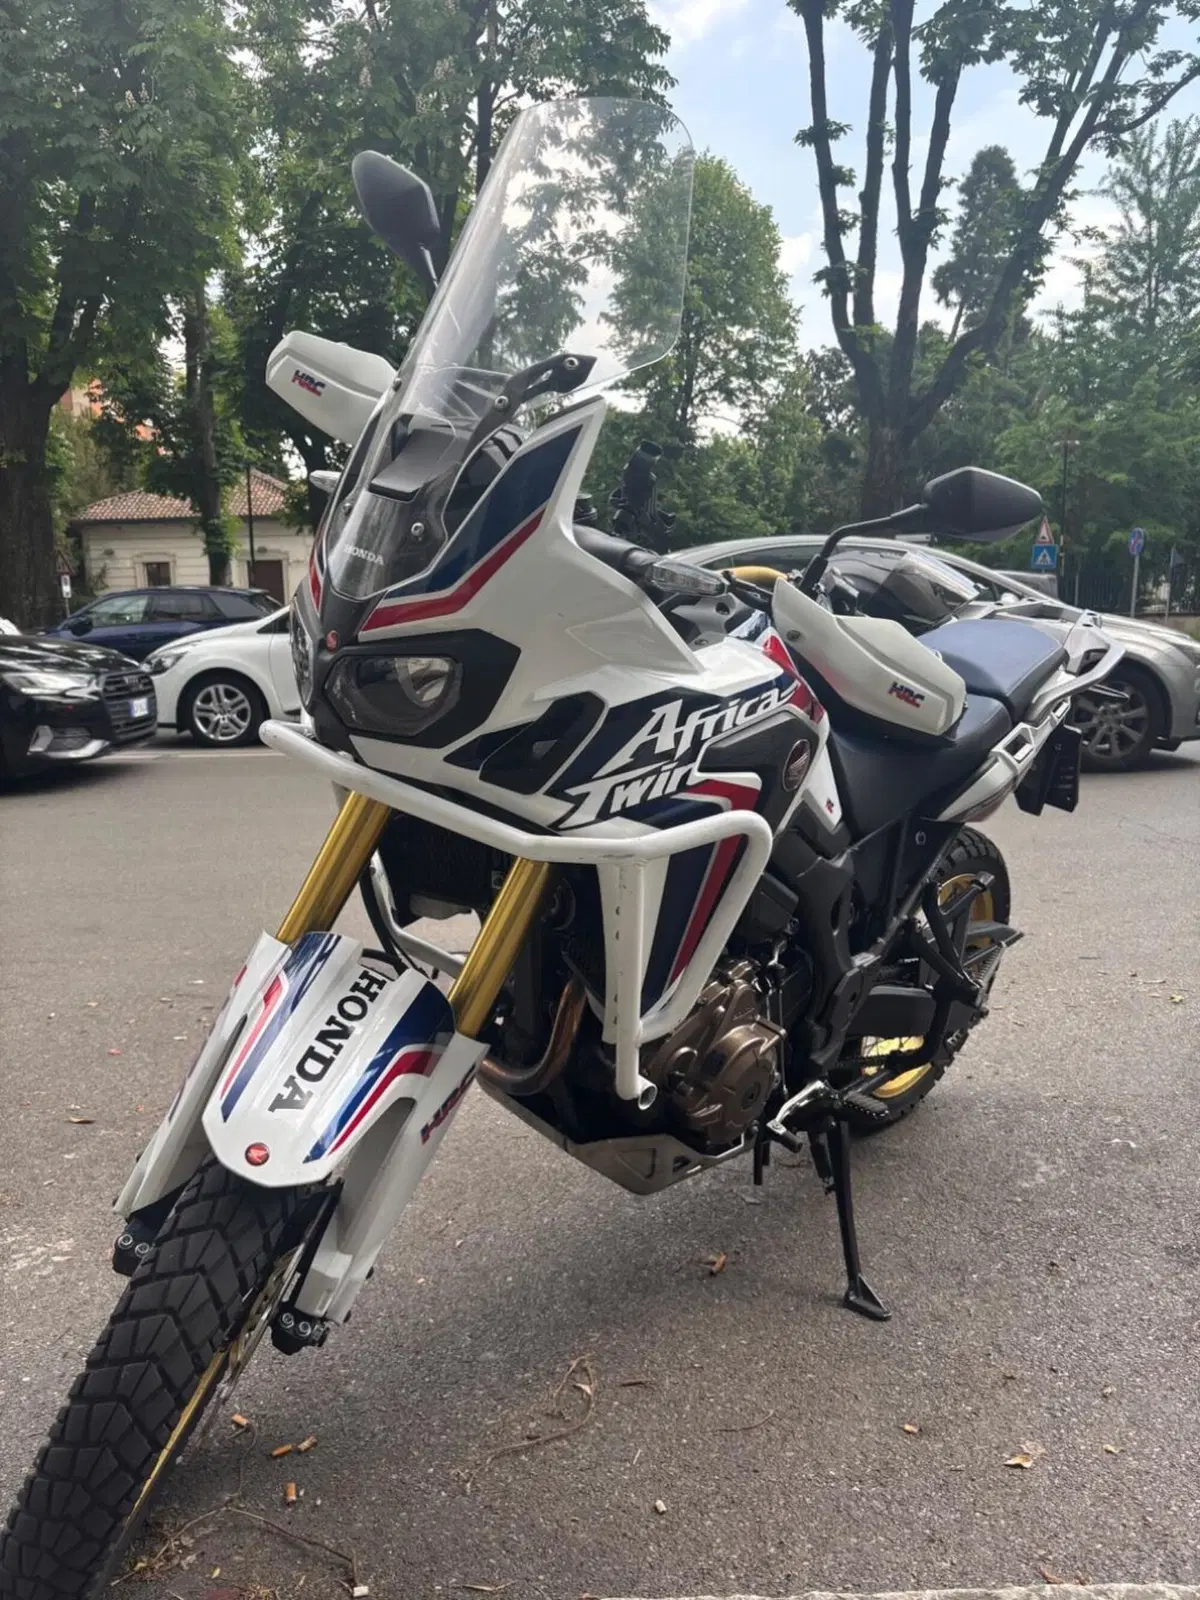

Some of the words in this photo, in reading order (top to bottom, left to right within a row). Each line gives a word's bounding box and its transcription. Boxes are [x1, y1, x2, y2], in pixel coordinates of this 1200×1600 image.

[343, 544, 384, 565] HONDA
[888, 681, 925, 708] HRC
[591, 680, 800, 779] Africa
[557, 760, 700, 829] Twin
[268, 970, 387, 1113] HONDA
